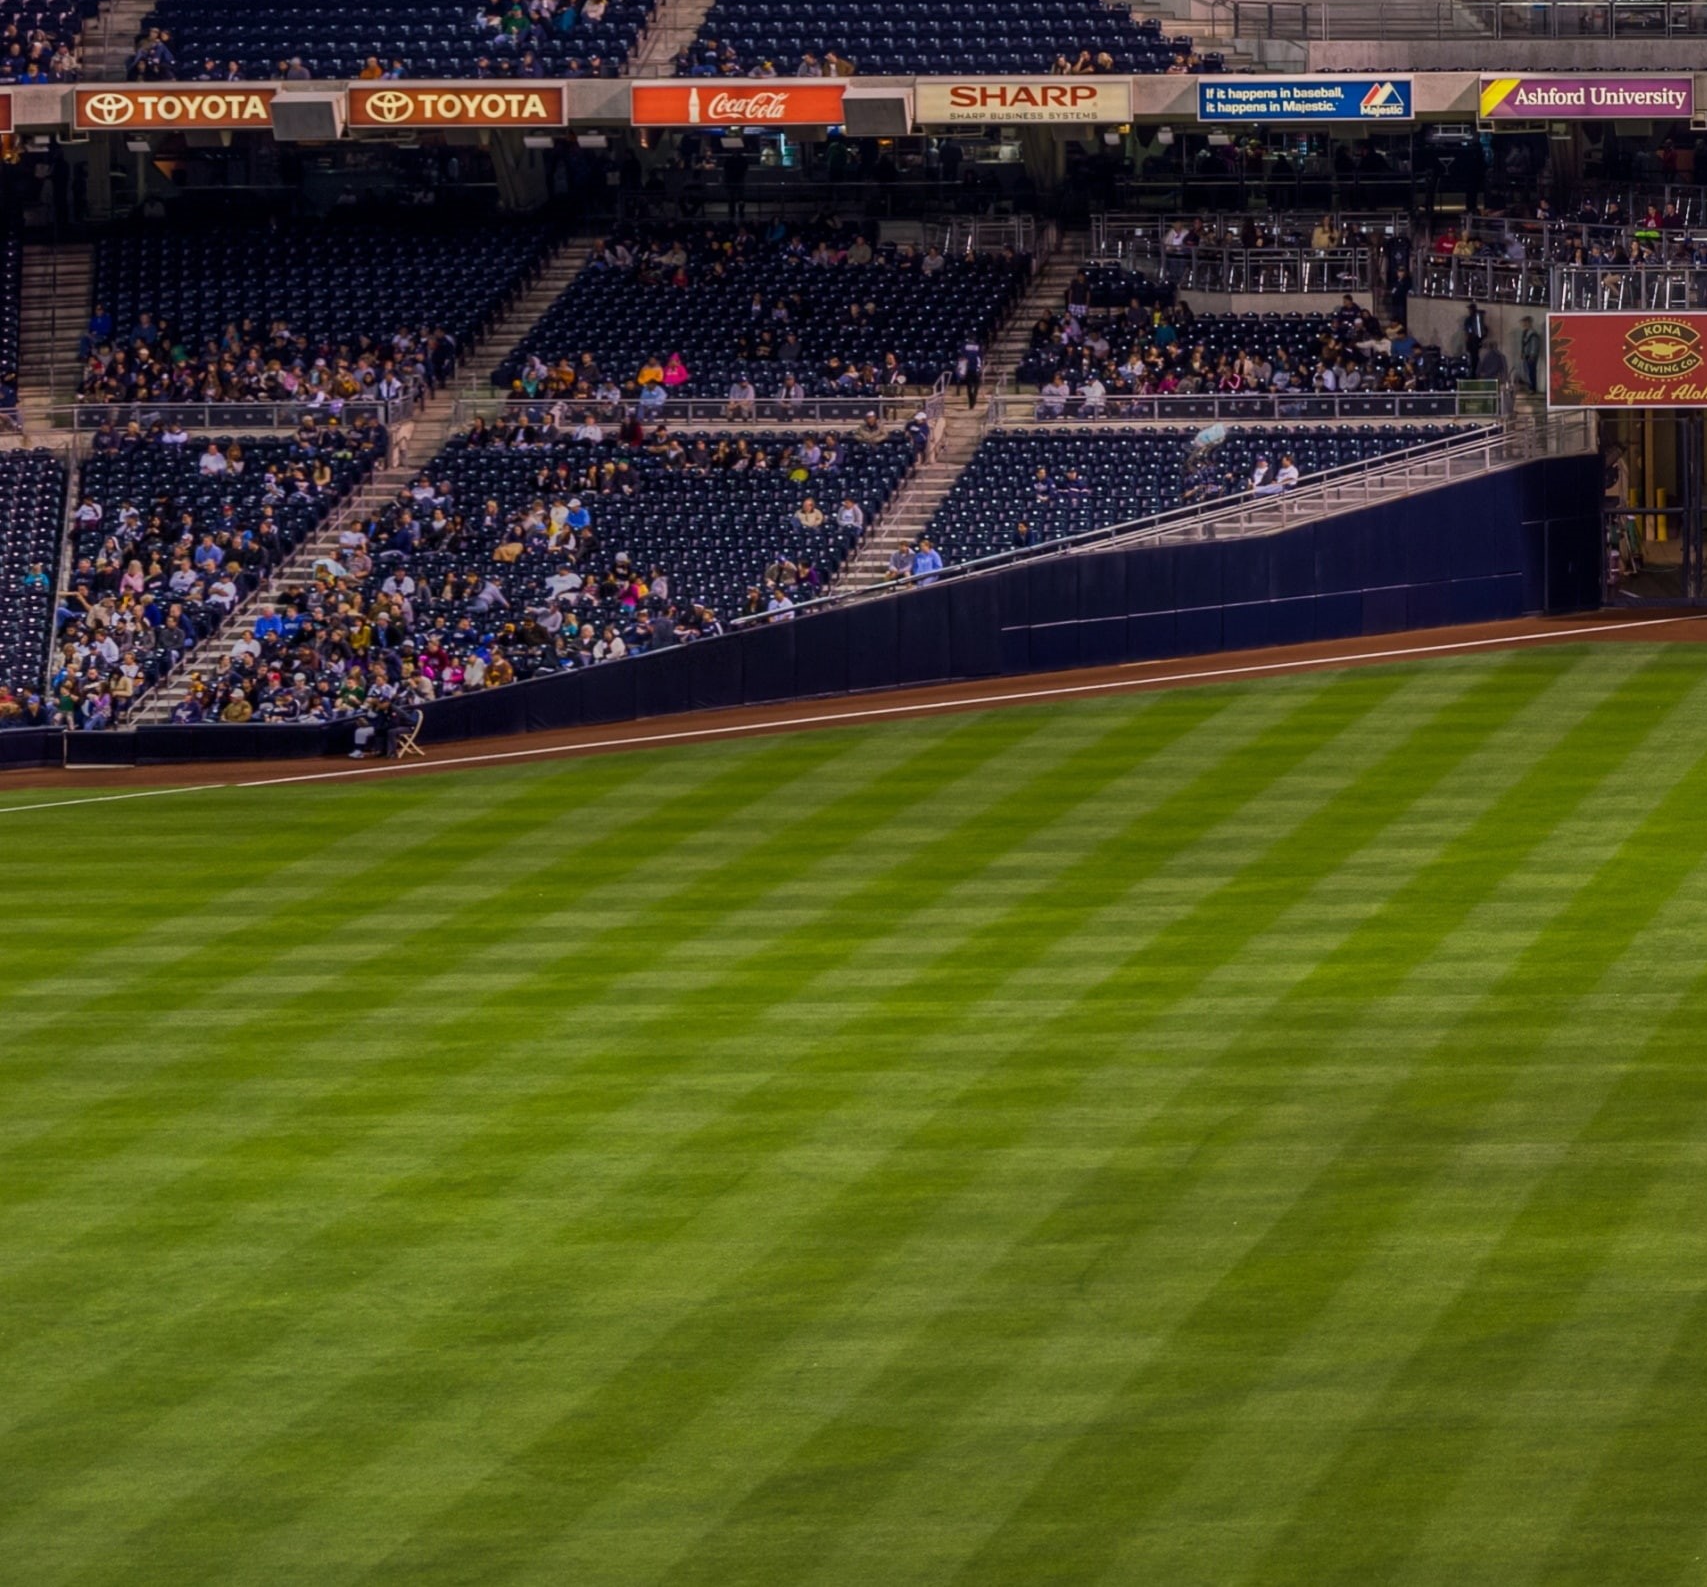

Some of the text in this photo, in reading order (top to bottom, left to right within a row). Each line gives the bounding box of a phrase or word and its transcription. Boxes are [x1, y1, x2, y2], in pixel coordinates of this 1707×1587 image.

[950, 86, 1097, 107] SHARP
[1206, 88, 1215, 99] If
[1216, 88, 1226, 99] it
[1228, 88, 1278, 101] happens
[1280, 87, 1291, 98] in
[1514, 86, 1687, 110] Ashford University
[138, 95, 267, 120] TOYOTA
[417, 93, 547, 120] TOYOTA
[1206, 101, 1215, 113] it
[1217, 101, 1267, 115] happens
[1269, 101, 1280, 112] in
[1361, 105, 1404, 117] Majestic
[950, 112, 1098, 120] SHARP BUSINESS SYSTEMS
[1643, 324, 1681, 337] KONA
[1630, 357, 1679, 374] BREWING
[1604, 383, 1664, 405] Liquid
